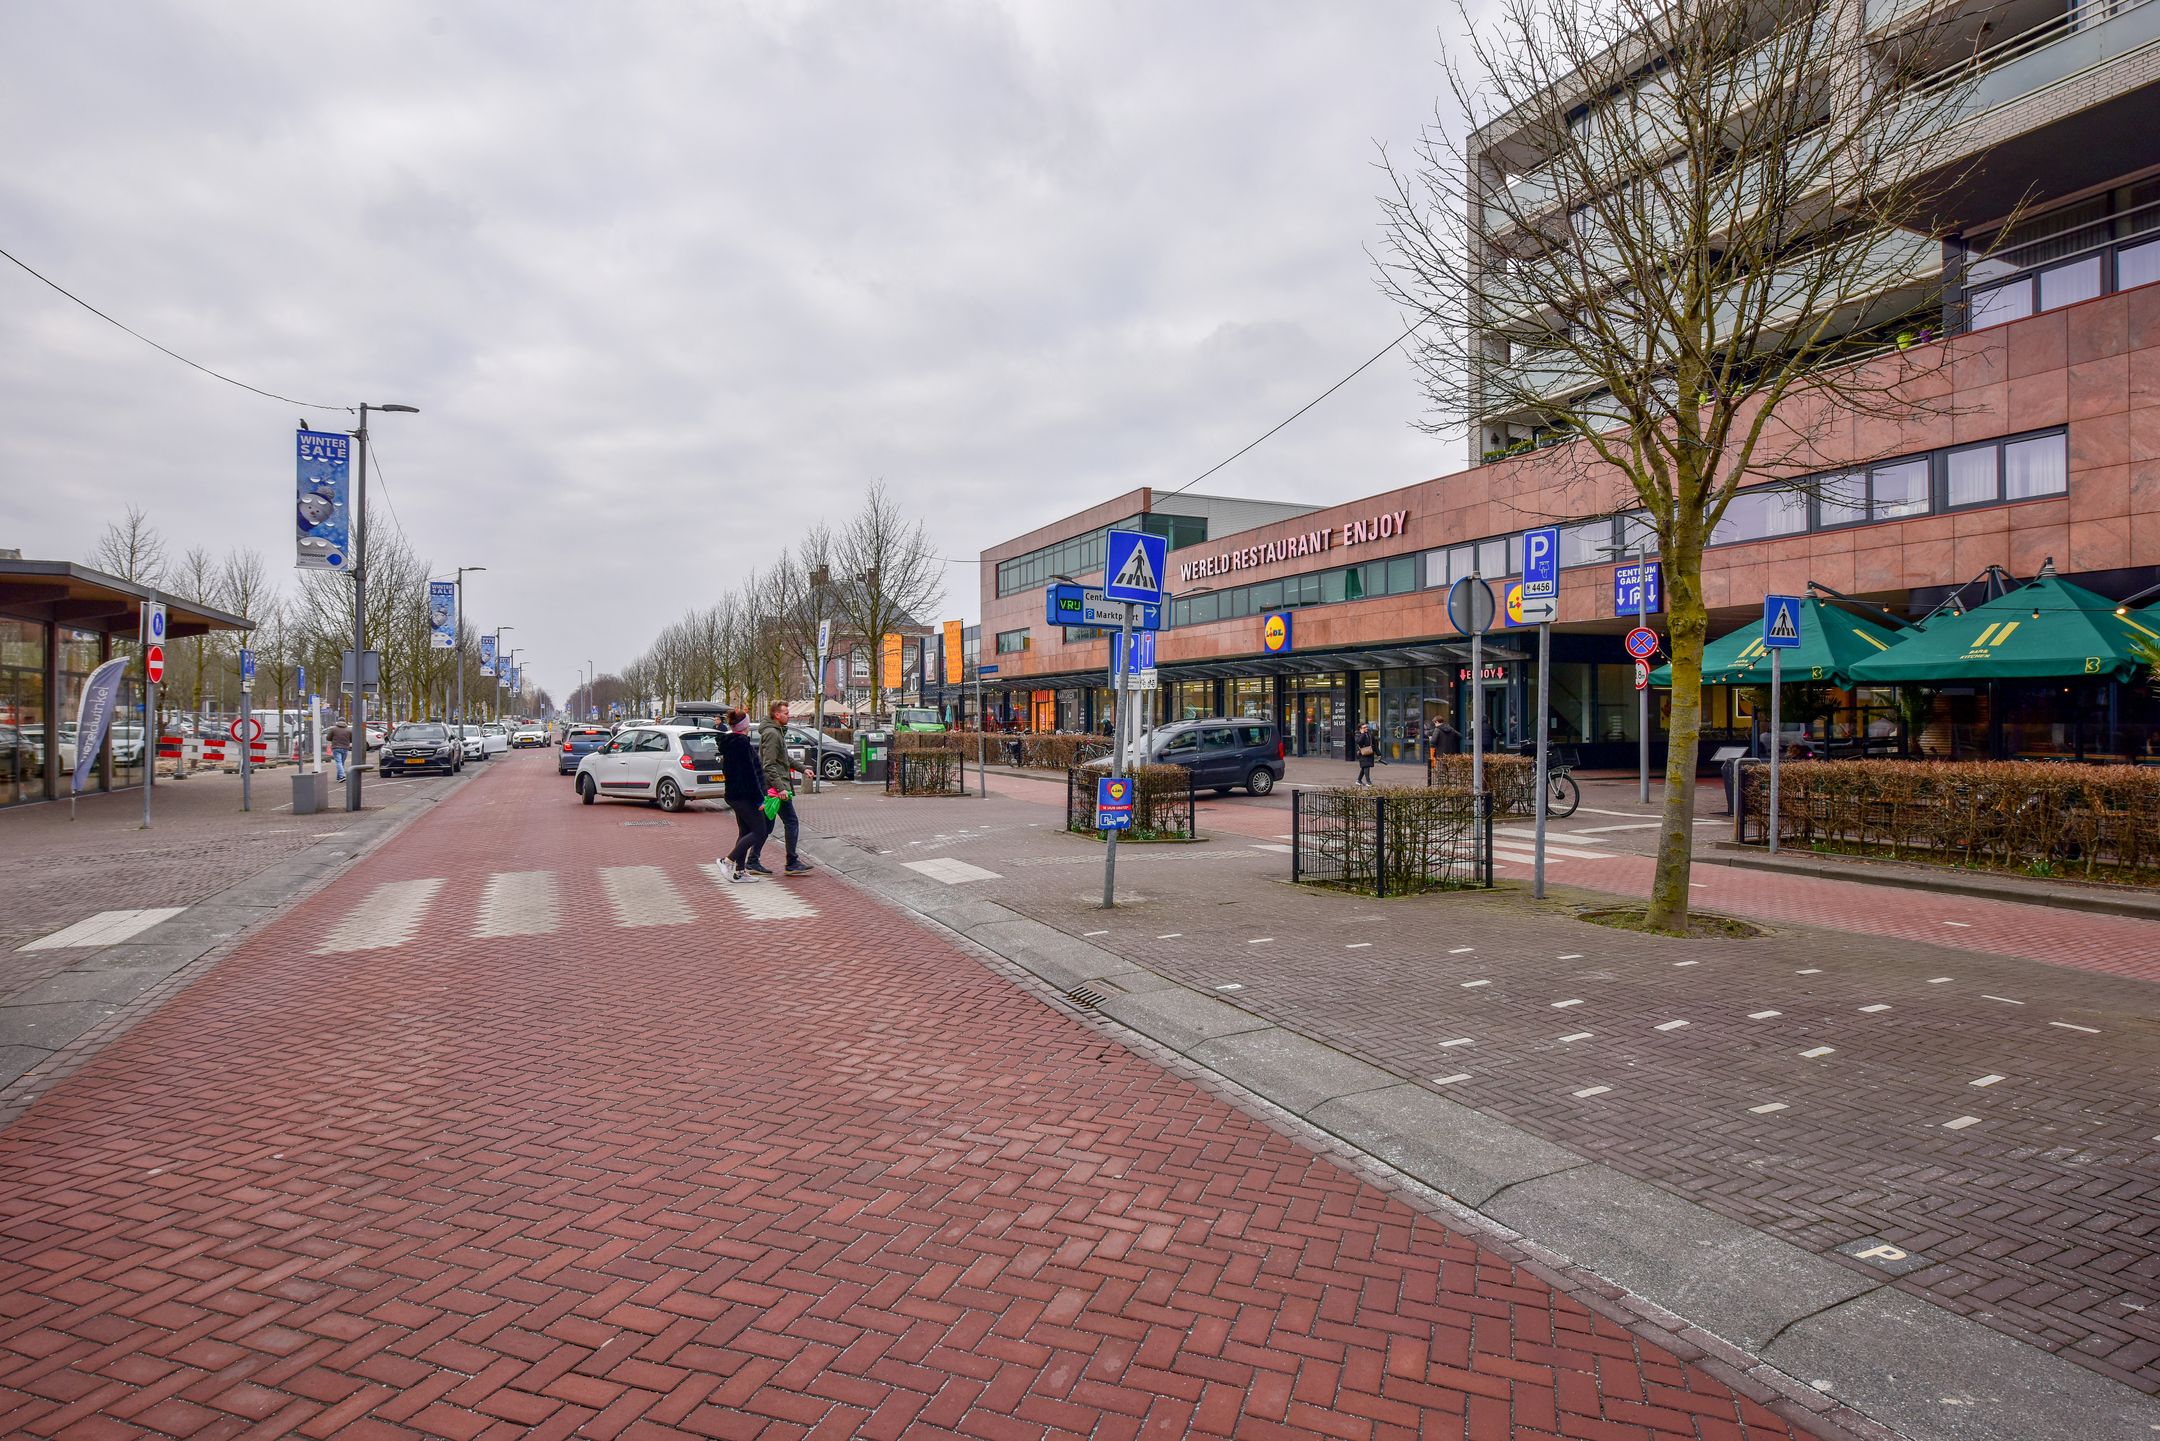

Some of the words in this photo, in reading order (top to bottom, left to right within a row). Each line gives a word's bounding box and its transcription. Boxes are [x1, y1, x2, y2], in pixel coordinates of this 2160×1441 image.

[300, 435, 346, 448] WINTER
[301, 444, 346, 458] SALE
[1180, 553, 1230, 582] WERELD
[1233, 528, 1333, 571] RESTAURANT
[1343, 510, 1408, 546] ENJOY
[1530, 535, 1549, 570] P
[1617, 565, 1656, 577] CENTUM
[1532, 582, 1550, 592] 4456
[1096, 610, 1139, 622] Marktprt
